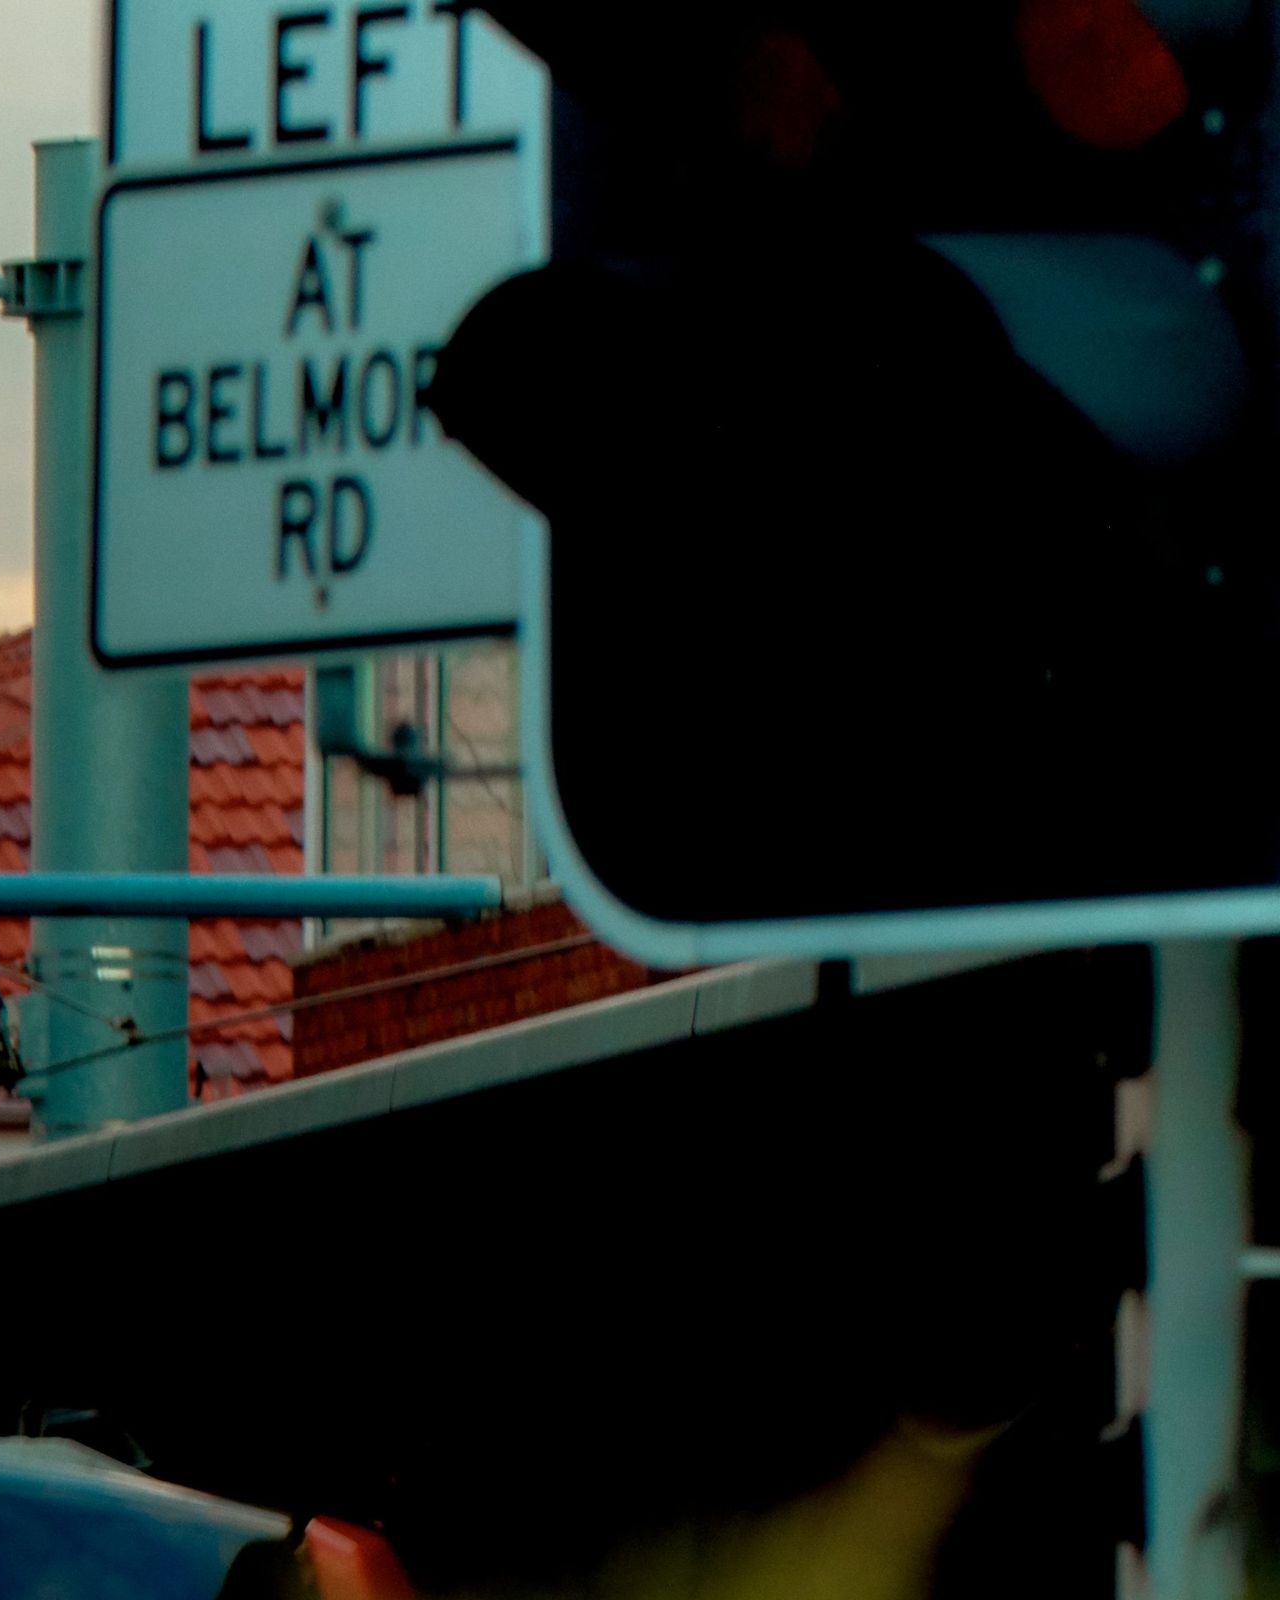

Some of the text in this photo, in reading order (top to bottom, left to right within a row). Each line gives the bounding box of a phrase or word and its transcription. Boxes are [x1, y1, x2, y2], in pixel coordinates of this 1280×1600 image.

[195, 5, 468, 150] LEFT
[286, 228, 374, 338] AT
[154, 347, 442, 470] BELMOR
[276, 474, 374, 580] RD
